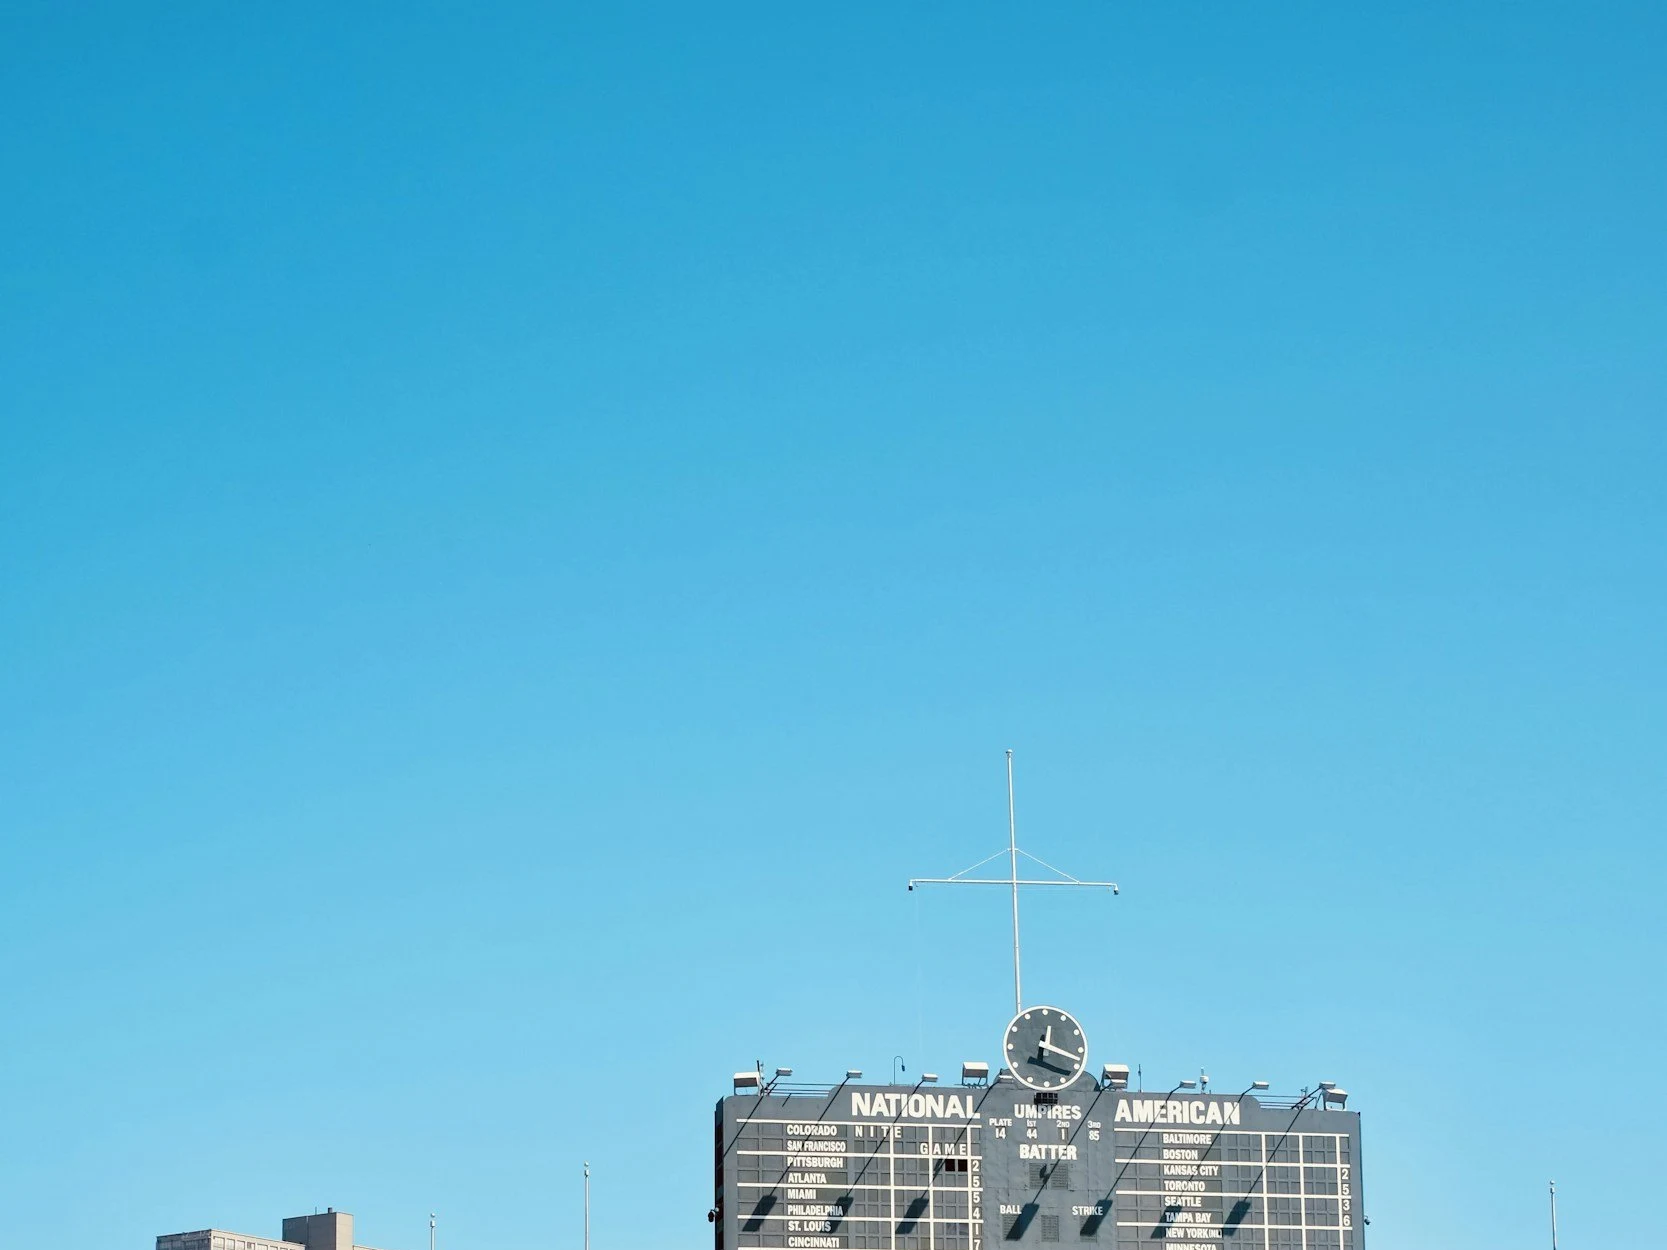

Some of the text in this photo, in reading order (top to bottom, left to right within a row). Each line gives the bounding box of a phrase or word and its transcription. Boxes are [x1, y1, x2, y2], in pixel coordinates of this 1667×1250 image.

[852, 1092, 980, 1119] NATIONAL
[1014, 1104, 1082, 1120] UMPIRES
[1114, 1099, 1240, 1125] AMERICAN
[787, 1124, 837, 1136] COLORADO
[989, 1118, 1012, 1127] PLATE
[995, 1128, 1099, 1141] 14 44 1 85
[1163, 1133, 1212, 1145] BALTIMORE
[787, 1141, 803, 1151] SAN
[804, 1141, 846, 1152] FRANCISCO
[1019, 1144, 1078, 1160] BATTER
[1163, 1149, 1198, 1160] BOSTON
[787, 1156, 980, 1172] PITTSBURGH 2
[1164, 1165, 1349, 1180] KANSAS CITY 2
[787, 1173, 980, 1188] ATLANTA 5
[1164, 1180, 1350, 1195] TORONTO 5
[787, 1189, 981, 1204] MIAMI 5
[1164, 1196, 1350, 1211] SEATTLE 3
[787, 1204, 981, 1220] PHILADELPHIA 4
[1000, 1205, 1103, 1216] BALL STRIKE
[1165, 1212, 1351, 1227] TAMPA BAY 6
[788, 1221, 980, 1235] ST. LOUIS 1
[1166, 1227, 1186, 1238] NEW
[788, 1237, 981, 1250] CINCINNATI 7
